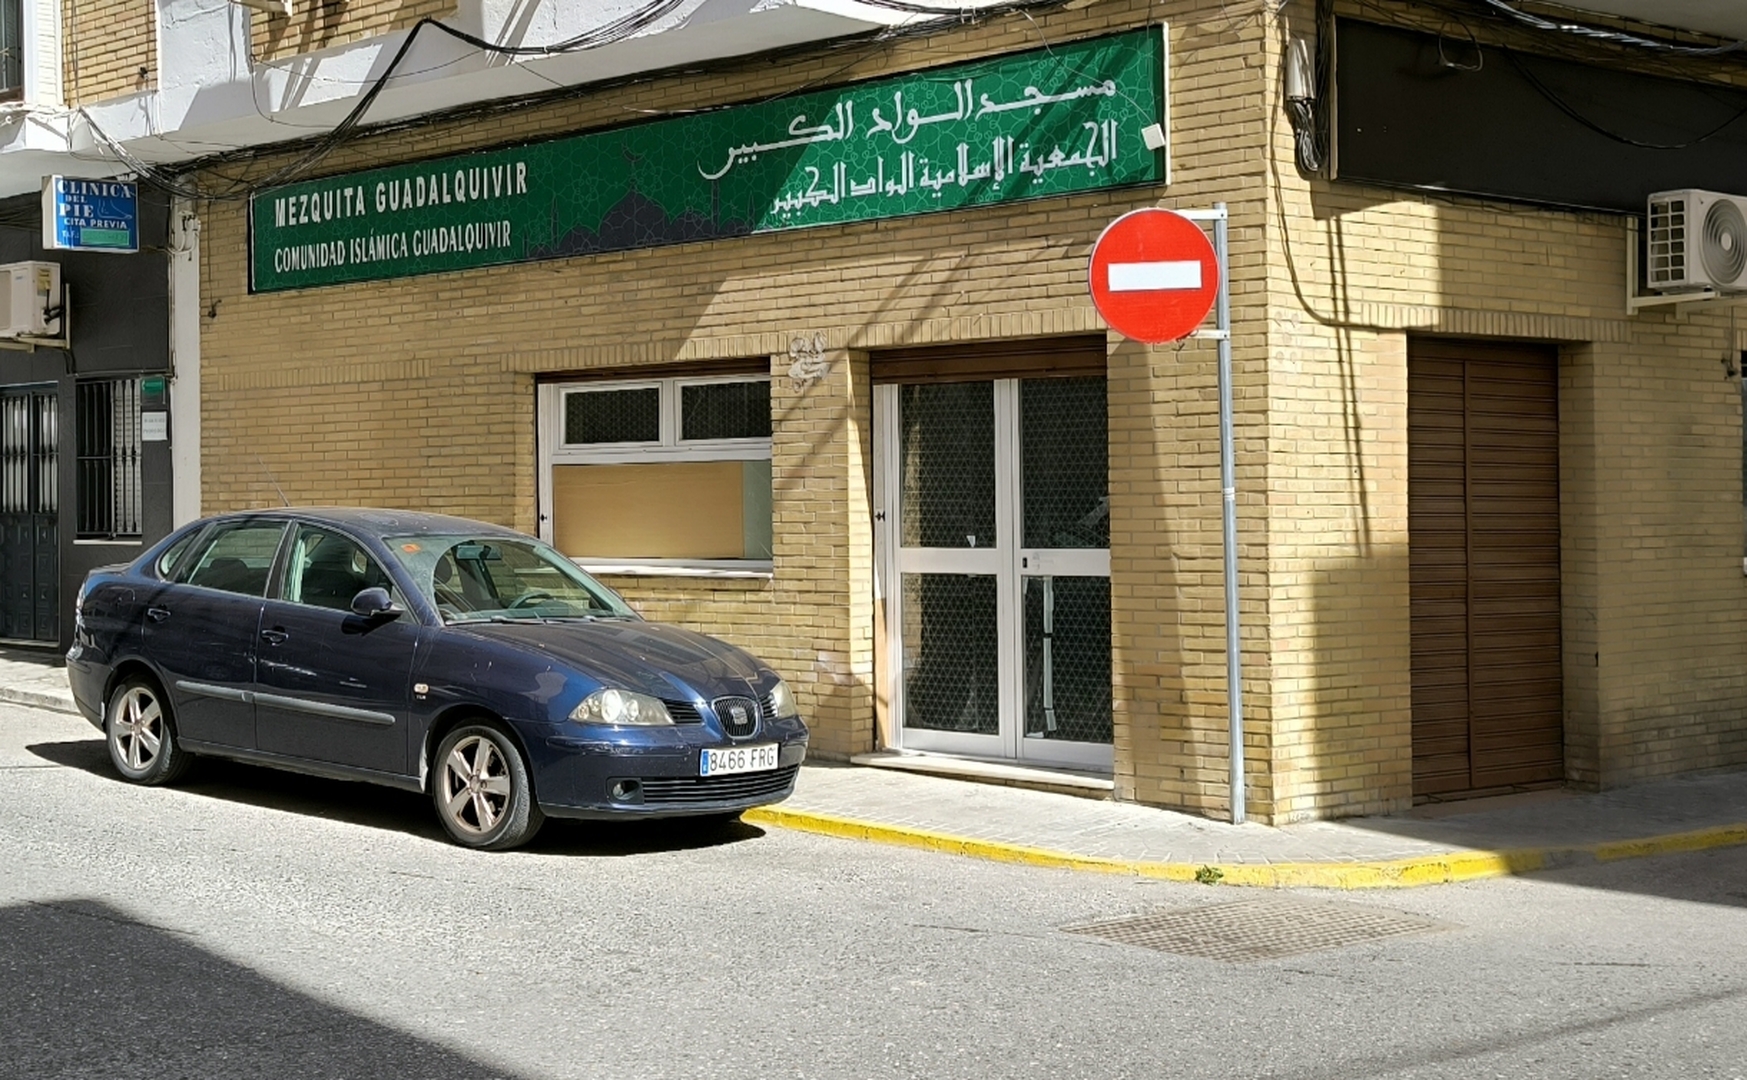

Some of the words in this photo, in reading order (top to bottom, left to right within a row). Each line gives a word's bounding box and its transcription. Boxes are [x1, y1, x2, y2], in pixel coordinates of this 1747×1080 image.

[866, 79, 973, 144] الواد
[974, 79, 1116, 121] مسجد
[697, 99, 854, 180] الكبير
[1019, 118, 1118, 184] الجمعية
[57, 179, 131, 198] CLINICA
[769, 161, 847, 218] الكبير
[919, 135, 1014, 198] الإسلامية
[59, 202, 94, 218] PIE
[65, 194, 87, 203] DEL
[275, 185, 366, 228] MEZQUITA
[375, 161, 527, 214] GUADALQUIVIR
[64, 217, 86, 226] CITA
[90, 218, 127, 229] PREVIA
[274, 240, 346, 273] COMUNIDAD
[350, 227, 408, 265] ISLÁMICA
[412, 220, 511, 257] GUADALQUIVIR
[710, 750, 745, 771] 8466
[750, 748, 774, 768] FRG
